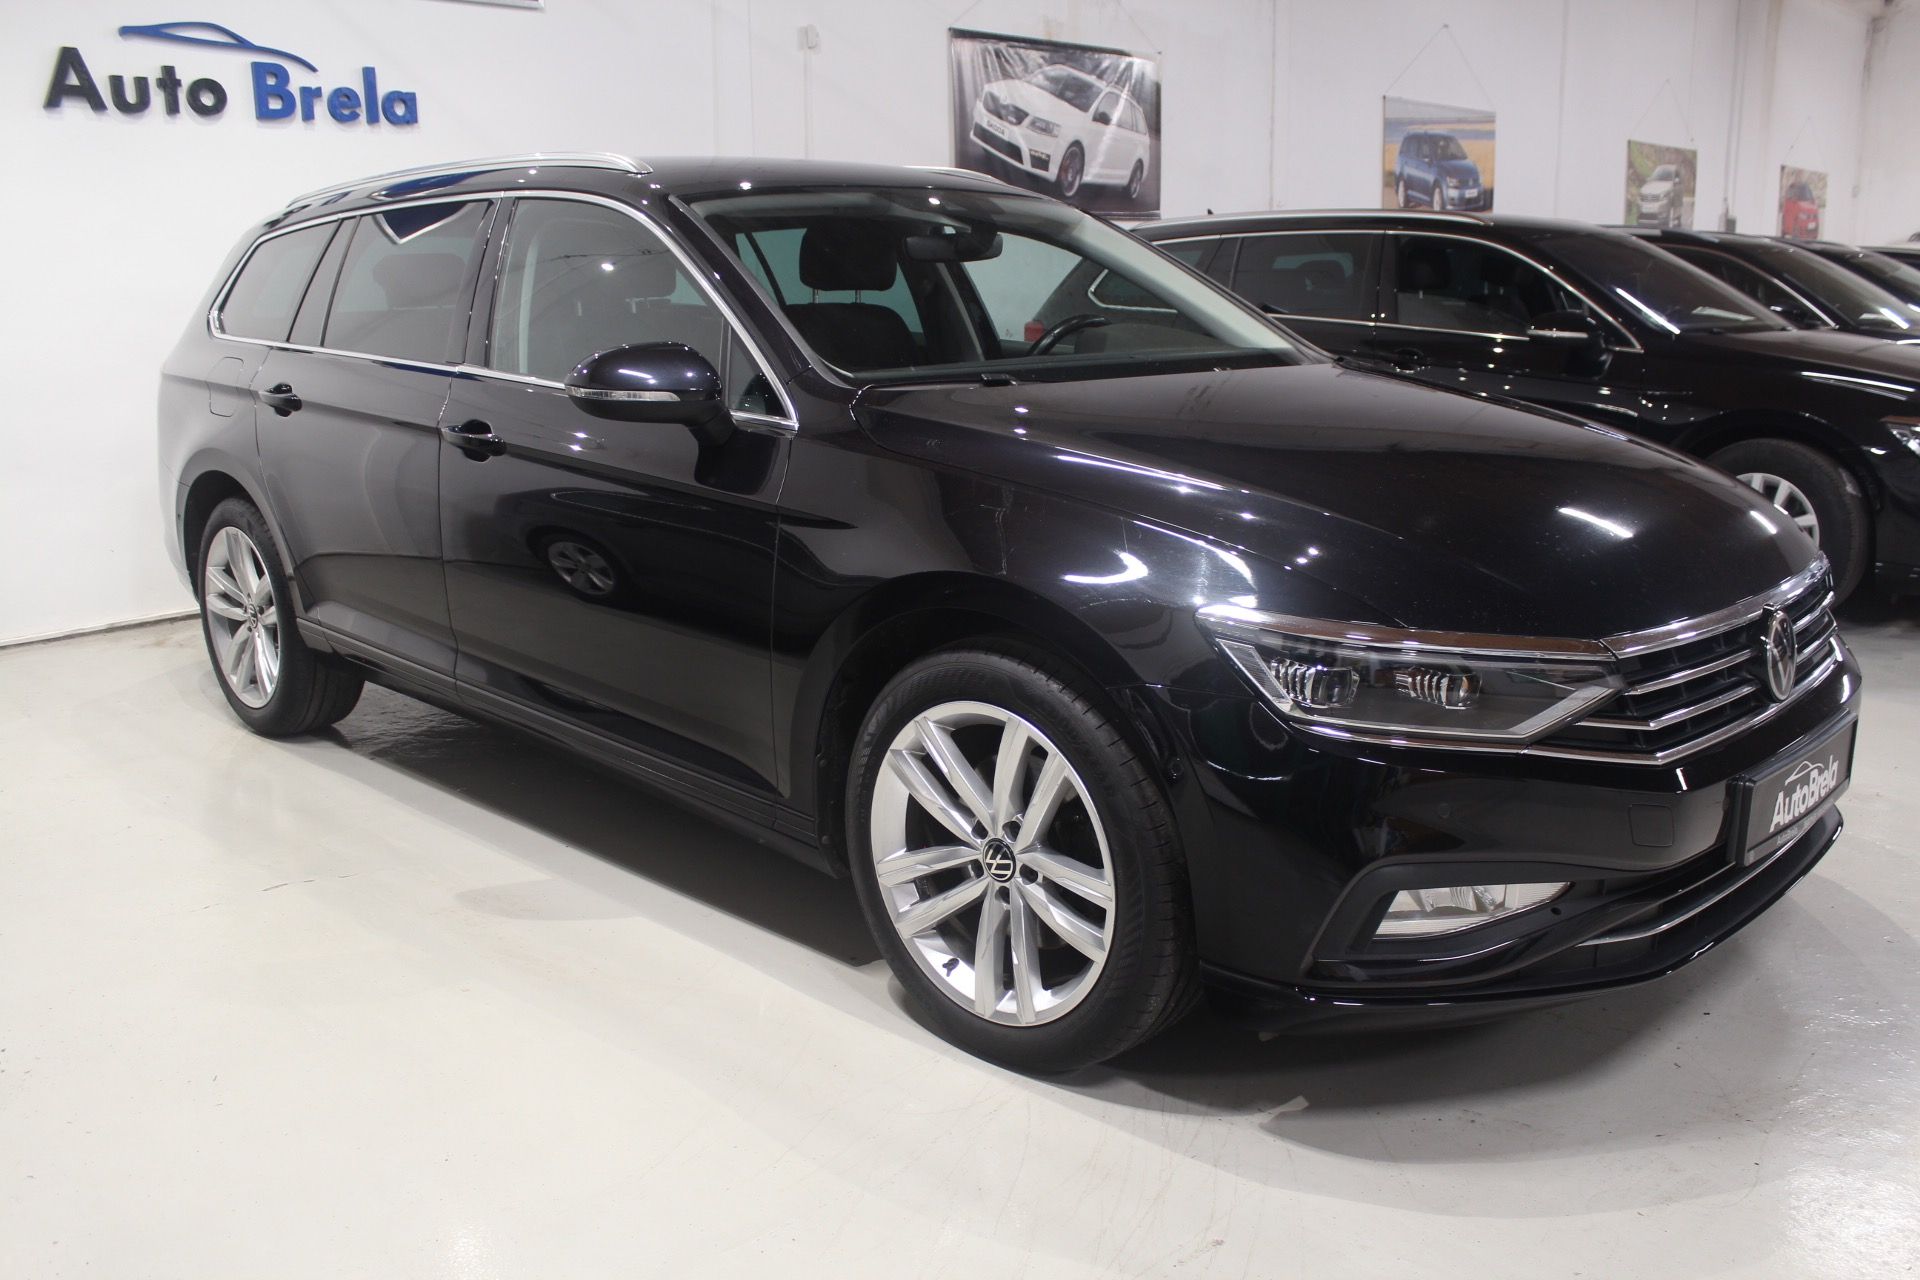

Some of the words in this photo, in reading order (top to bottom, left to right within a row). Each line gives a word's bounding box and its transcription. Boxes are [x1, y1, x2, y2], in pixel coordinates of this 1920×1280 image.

[43, 46, 228, 116] Auto
[250, 61, 418, 126] Brela
[1769, 754, 1839, 833] AutoBrela
